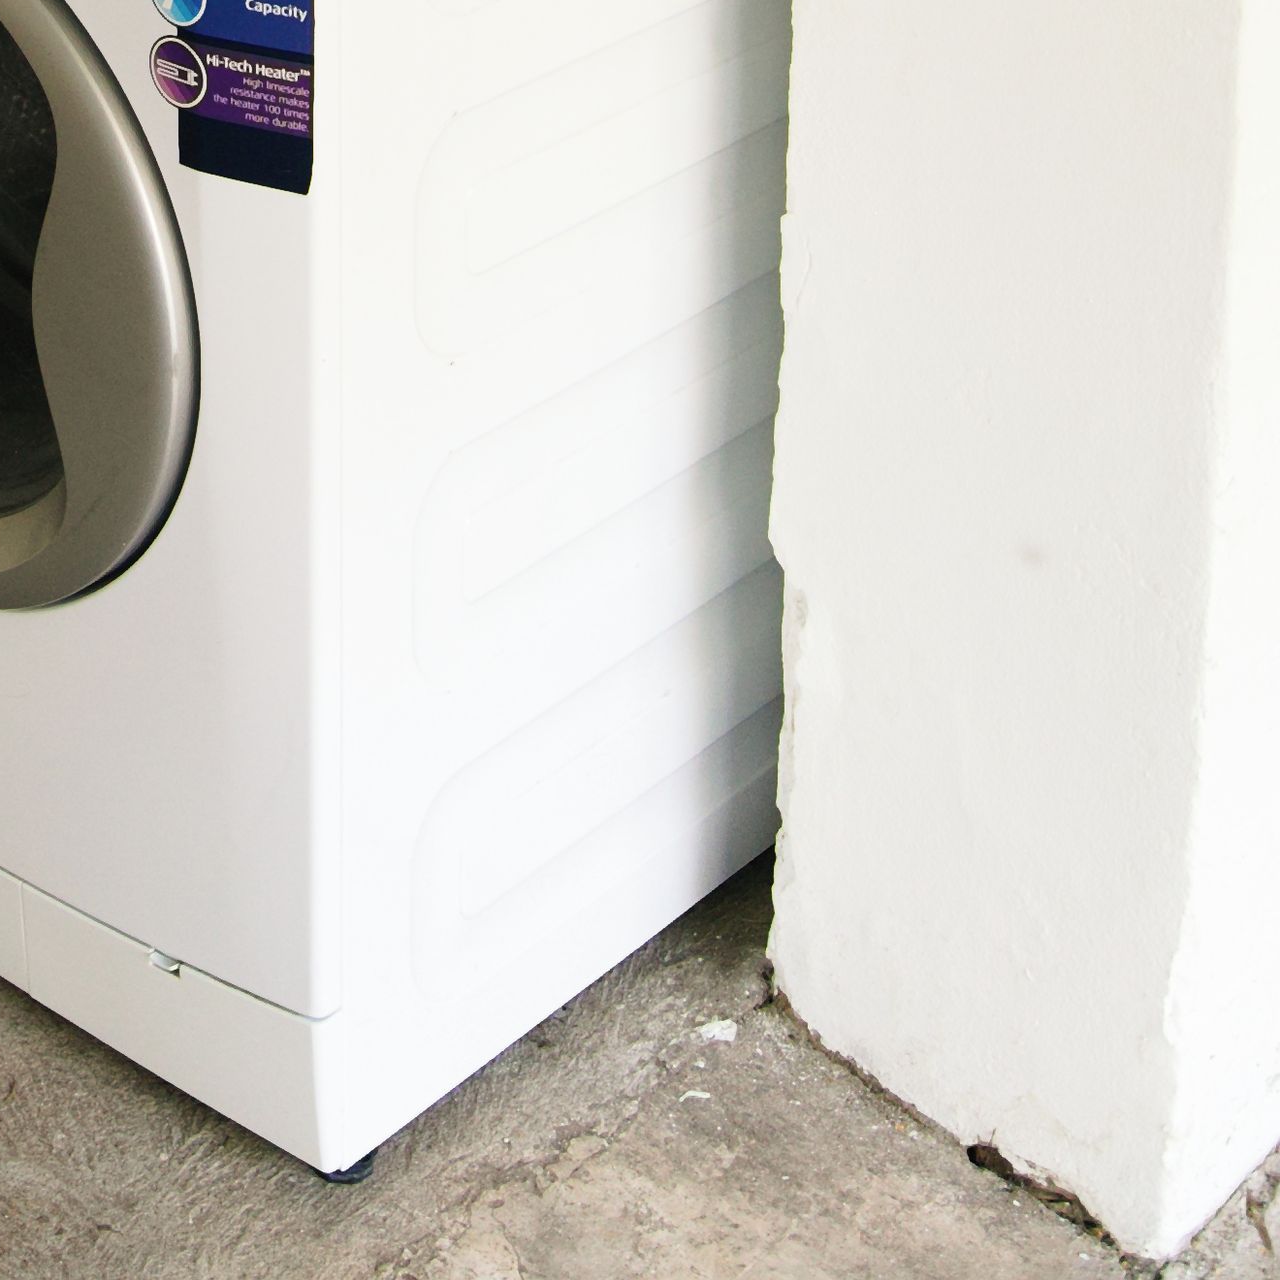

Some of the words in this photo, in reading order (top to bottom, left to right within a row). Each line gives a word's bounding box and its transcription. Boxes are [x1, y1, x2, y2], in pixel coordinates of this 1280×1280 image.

[206, 53, 252, 74] Hi-Tech
[230, 87, 276, 103] resistance
[278, 96, 310, 109] makes
[242, 77, 263, 90] High
[266, 80, 310, 98] timescale
[213, 93, 228, 105] the
[230, 97, 260, 111] heater
[264, 104, 281, 115] 100
[283, 108, 310, 121] times
[245, 112, 270, 124] more
[272, 118, 309, 133] durable.
